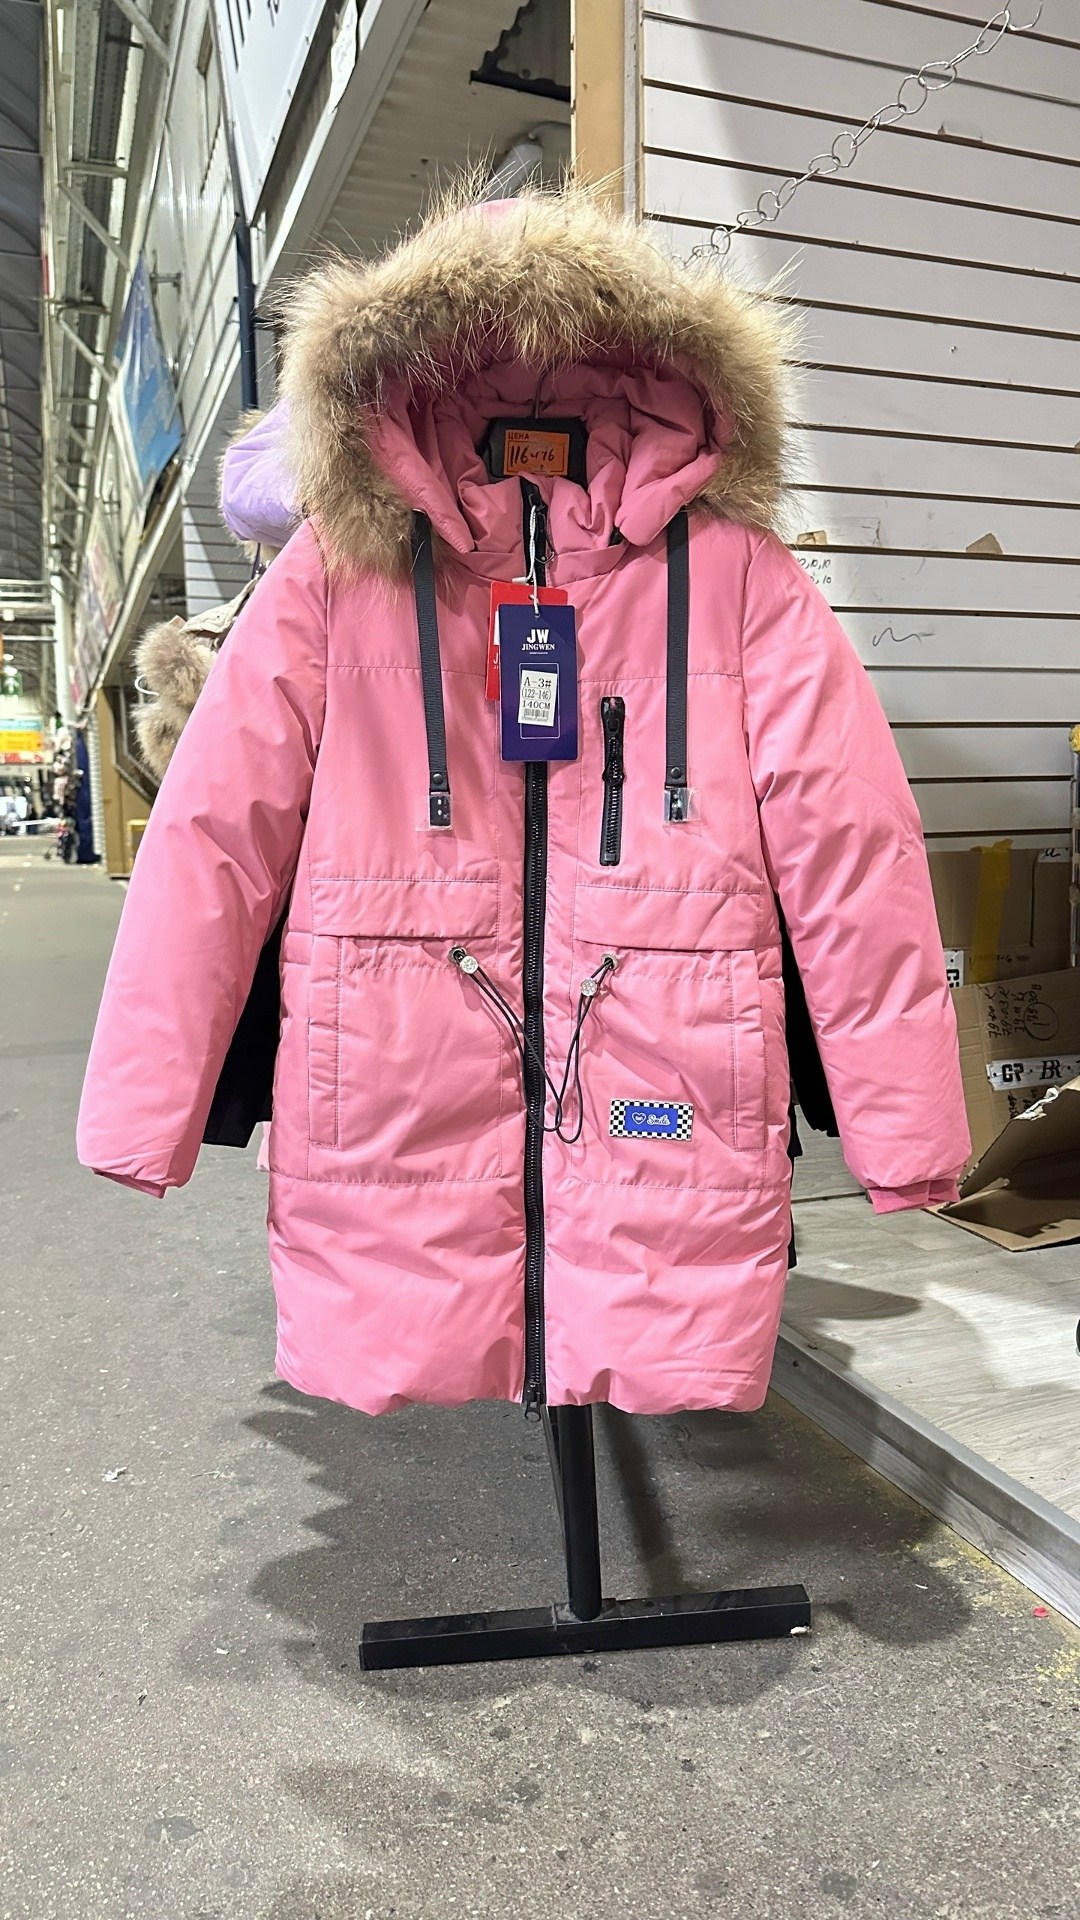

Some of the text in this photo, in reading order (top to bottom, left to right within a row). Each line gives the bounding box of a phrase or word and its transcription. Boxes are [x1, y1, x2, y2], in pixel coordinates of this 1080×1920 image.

[508, 432, 529, 440] ЦЕНА
[526, 628, 549, 643] JW
[521, 643, 555, 651] JINGWEN
[521, 687, 552, 701] (122-146)
[523, 700, 551, 710] 140CM
